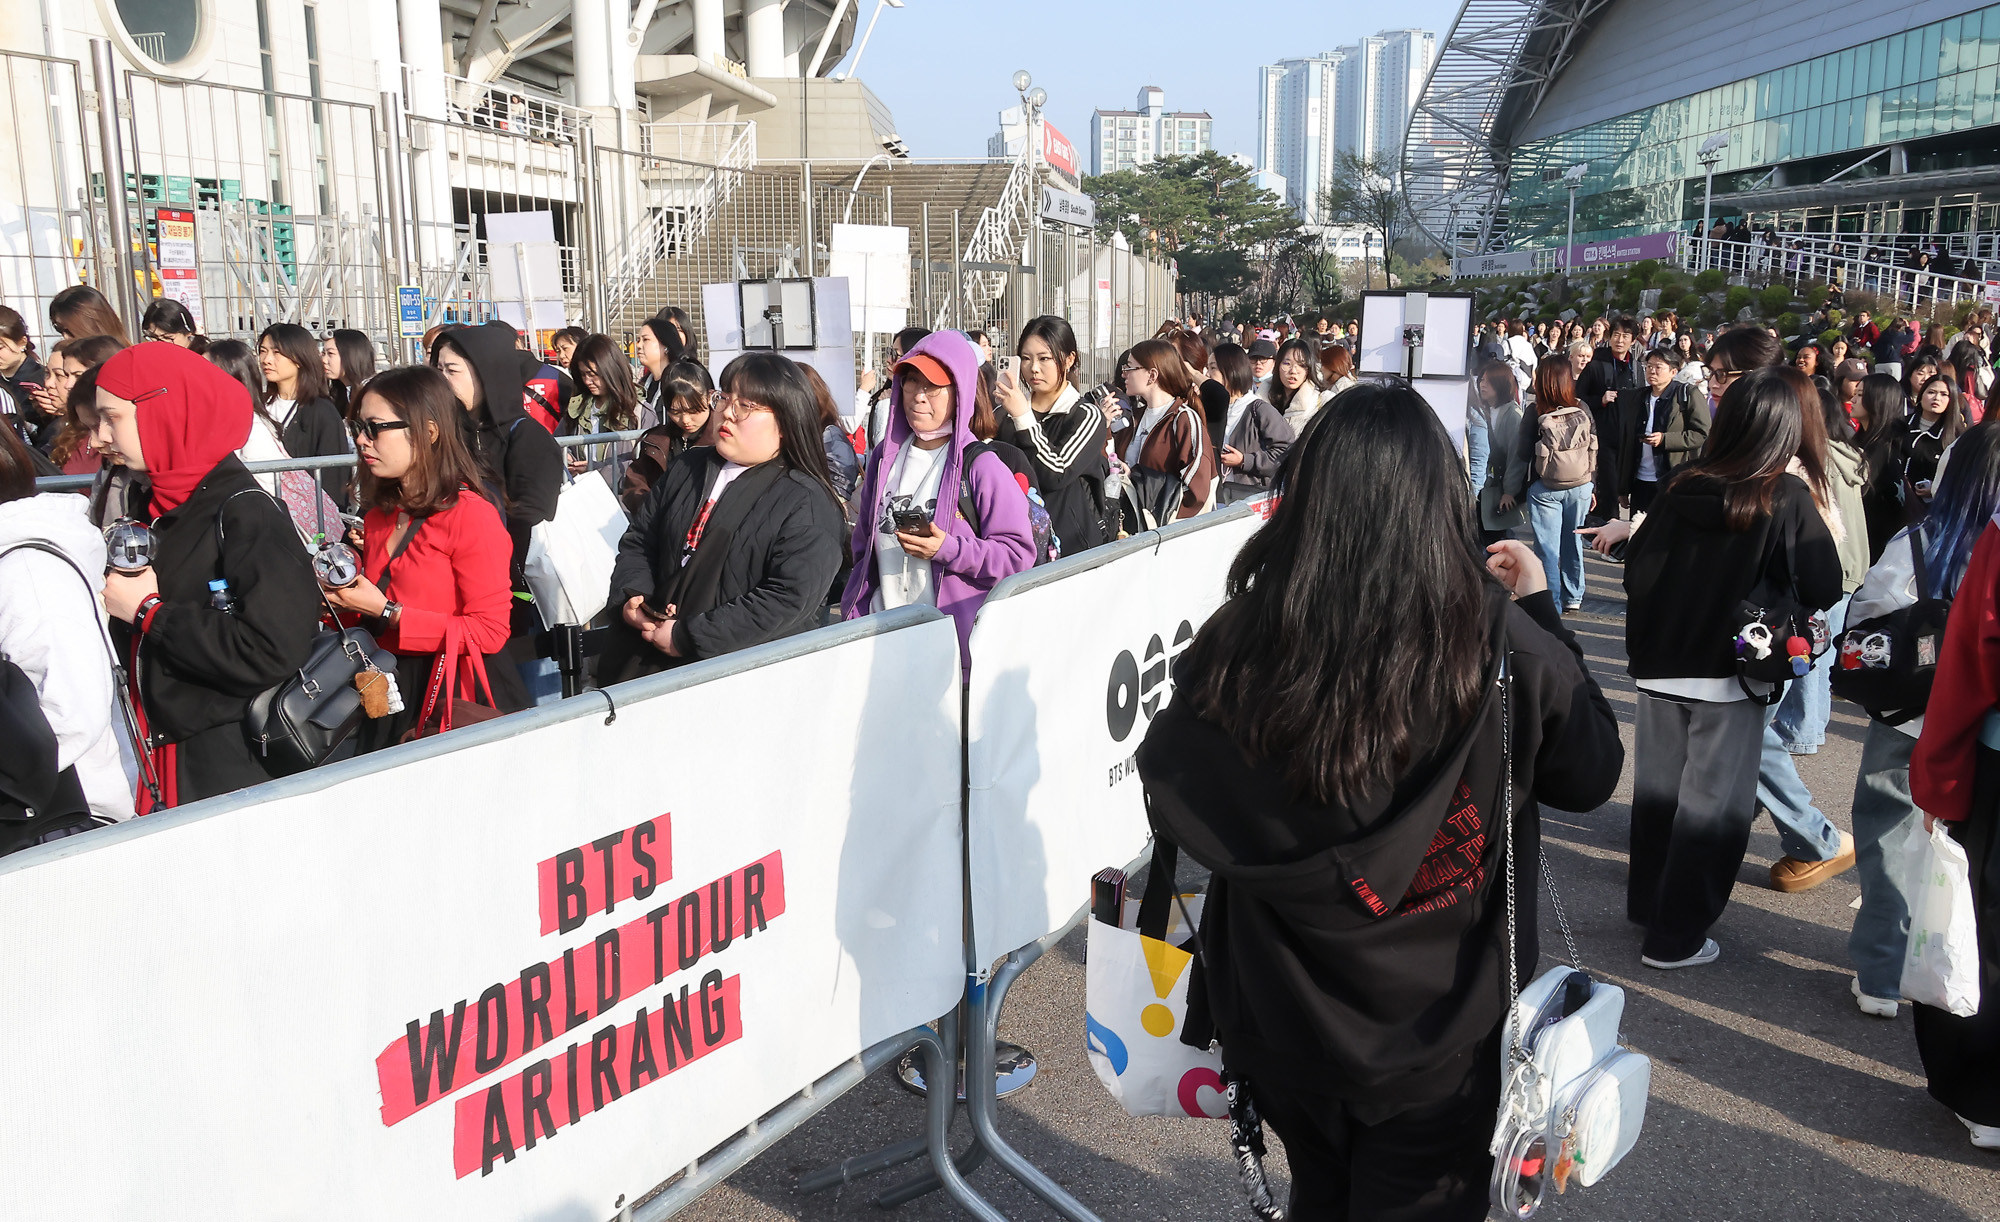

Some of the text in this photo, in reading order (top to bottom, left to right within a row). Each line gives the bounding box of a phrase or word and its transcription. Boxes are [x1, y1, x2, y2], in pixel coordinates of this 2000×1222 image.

[167, 225, 182, 237] 재입장
[1598, 244, 1617, 260] 킨텍스역
[400, 293, 420, 306] 1601-55
[1109, 762, 1122, 788] BTS
[556, 820, 657, 935] BTS
[406, 862, 768, 1107] WORLD TOUR
[482, 968, 726, 1178] ARIRANG
